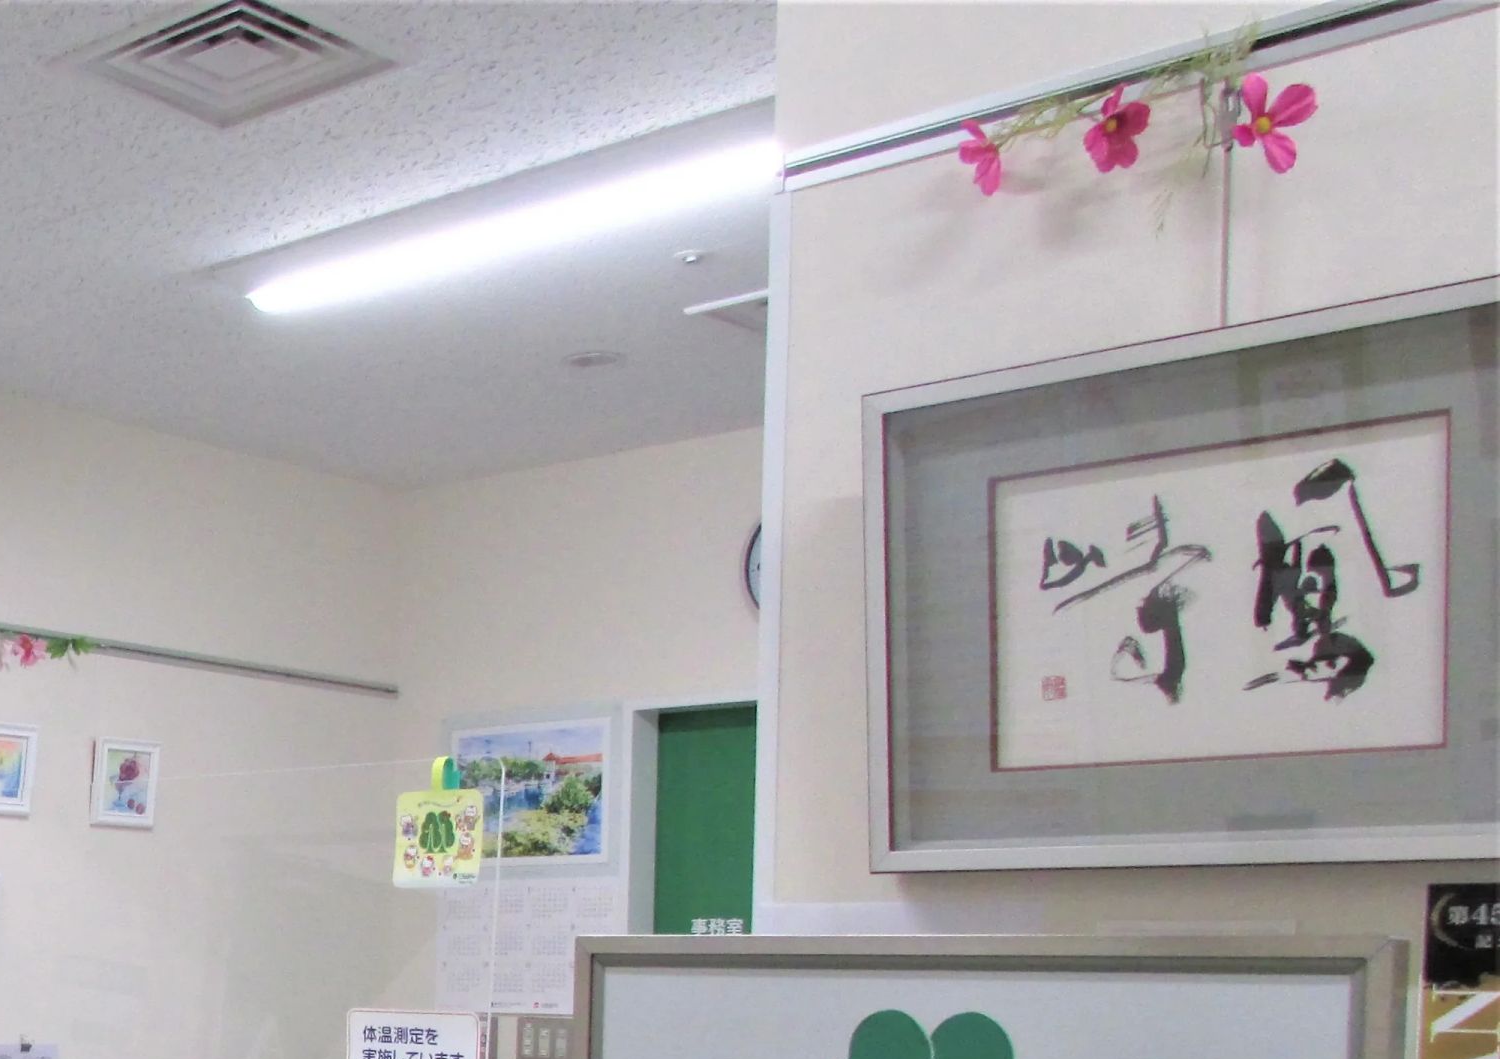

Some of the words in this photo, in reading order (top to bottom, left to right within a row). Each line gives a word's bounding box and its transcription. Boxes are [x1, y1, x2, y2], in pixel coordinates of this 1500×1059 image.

[691, 918, 744, 936] 事務室
[363, 1026, 438, 1046] 体温測定を
